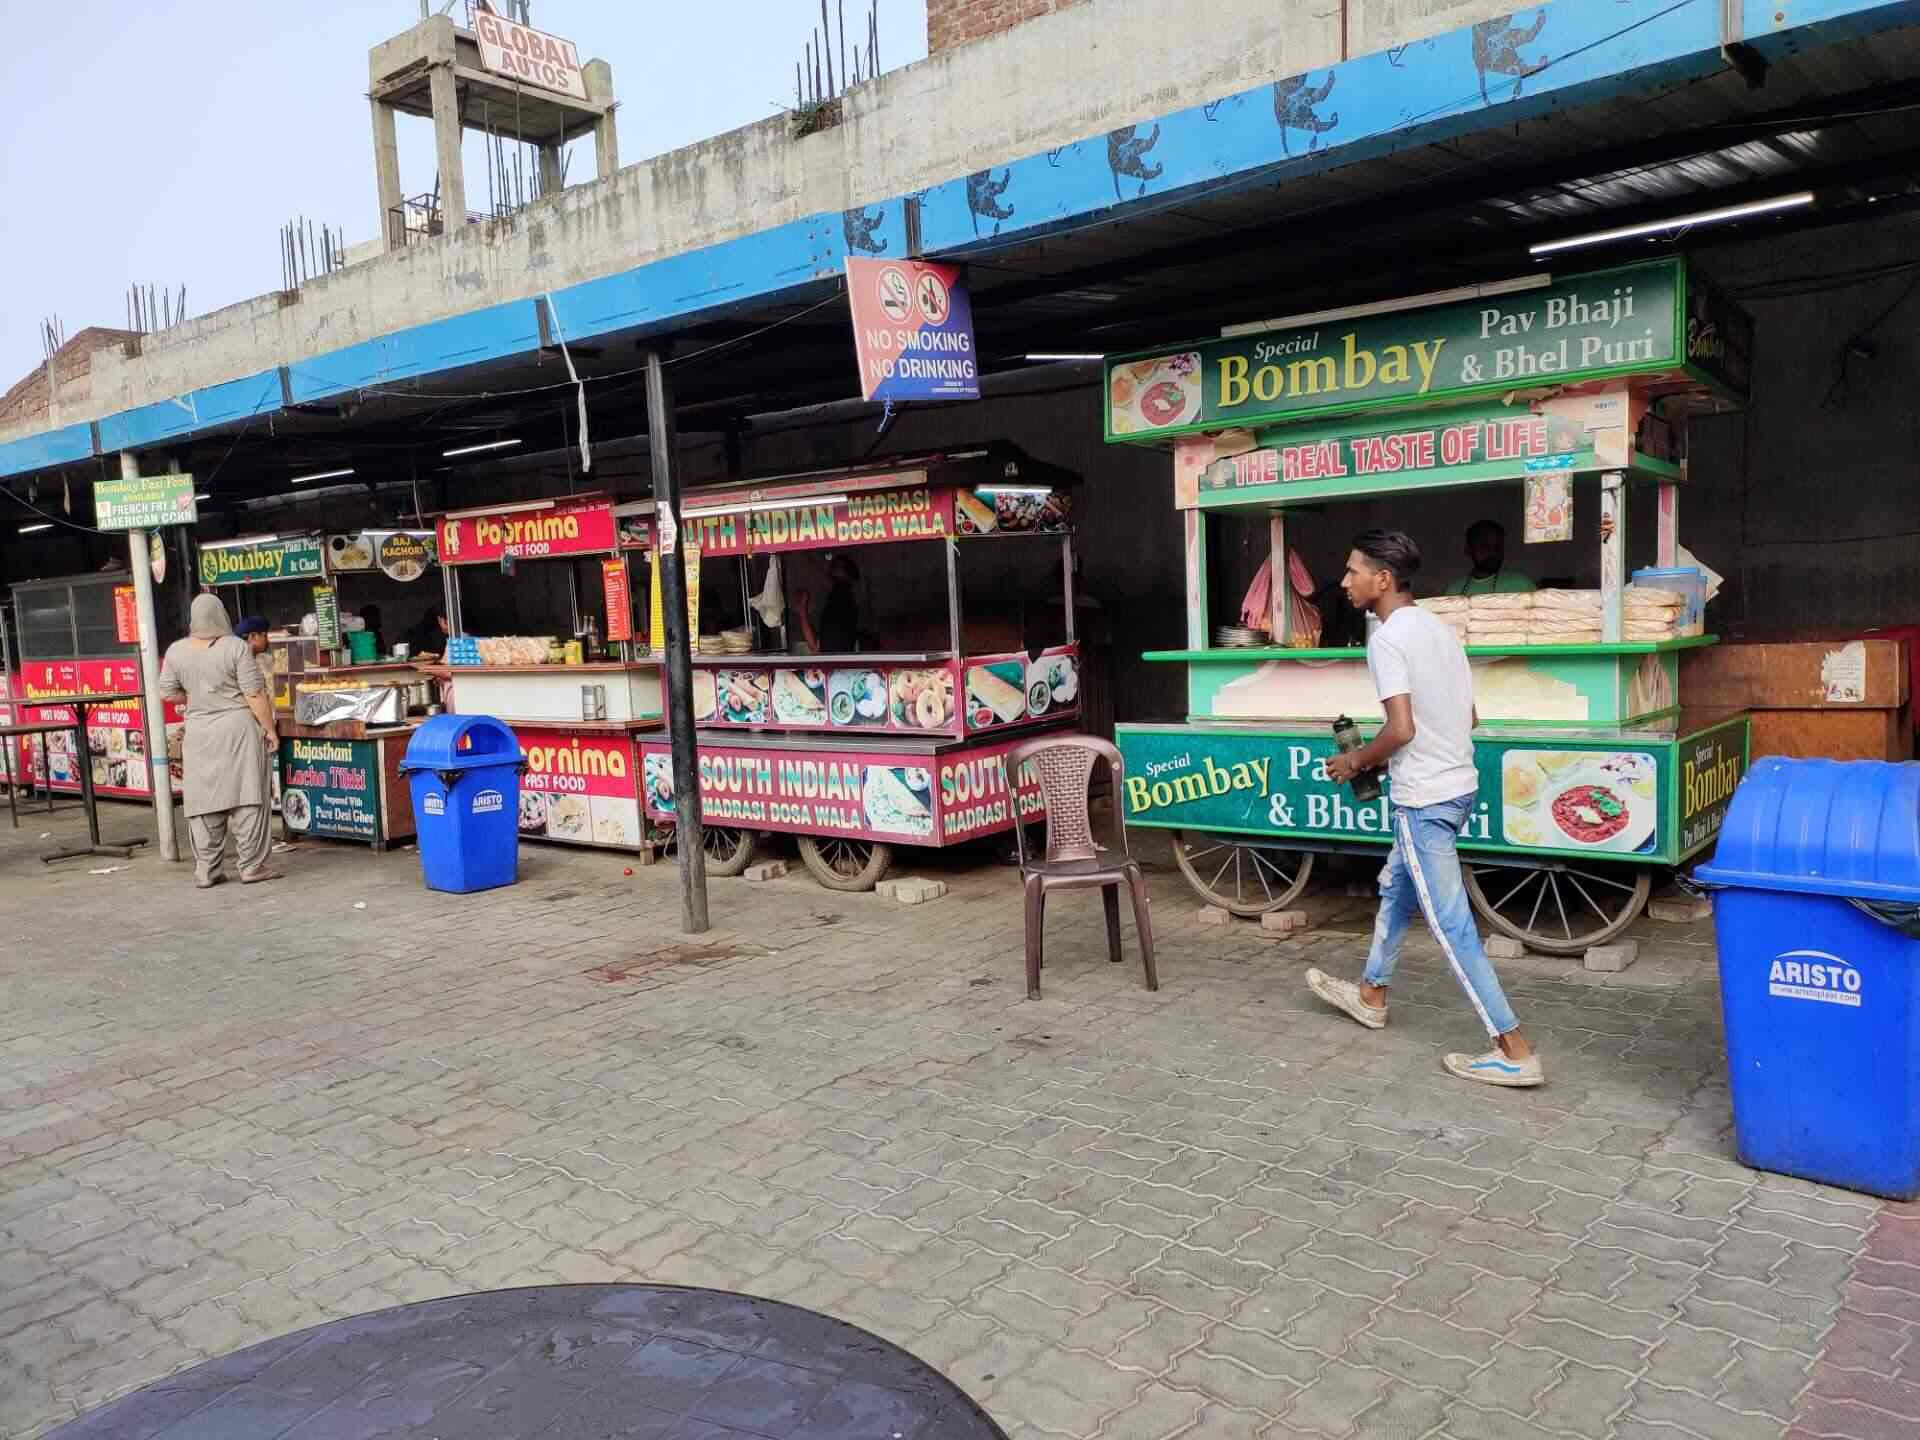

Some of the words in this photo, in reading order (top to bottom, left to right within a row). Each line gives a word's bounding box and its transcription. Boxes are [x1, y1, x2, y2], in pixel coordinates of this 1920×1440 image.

[479, 15, 578, 72] GLOBAL
[502, 51, 568, 88] AUTOS
[1479, 308, 1536, 340] Pav
[1544, 286, 1635, 328] Bhaji
[865, 329, 892, 350] NO
[896, 330, 970, 352] SMOKING
[1254, 331, 1319, 362] Special
[1460, 354, 1482, 384] &
[1495, 339, 1569, 380] Bhel
[1581, 328, 1655, 368] Puri
[869, 358, 895, 378] NO
[899, 358, 974, 379] DRINKING
[1216, 332, 1447, 408] Bombay
[1231, 451, 1278, 486] THE
[1282, 442, 1346, 482] REAL
[1352, 429, 1436, 474] TASTE
[1441, 424, 1482, 465] OF
[1485, 416, 1548, 460] LIFE
[847, 489, 931, 518] MADRASI
[476, 512, 579, 546] Poornima
[745, 505, 836, 545] INDIAN
[837, 517, 887, 542] DOSA
[892, 511, 945, 536] WALA
[218, 547, 284, 577] Bombay
[525, 542, 550, 555] FOOD
[293, 739, 353, 764] Rajasthani
[1145, 752, 1192, 778] Special
[1287, 745, 1330, 782] Pa
[525, 774, 550, 789] FAST
[552, 776, 586, 791] FOOD
[700, 755, 773, 795] SOUTH
[778, 759, 860, 801] INDIAN
[1124, 755, 1272, 814] Bombay
[1684, 744, 1740, 818] Bombay
[315, 806, 333, 819] Pure
[334, 807, 352, 821] Desi
[353, 809, 375, 824] Ghee
[472, 793, 503, 807] ARISTO
[702, 797, 766, 822] MADRASI
[770, 802, 812, 826] DOSA
[815, 804, 862, 830] WALA
[1267, 792, 1296, 827] &
[1304, 793, 1391, 832] Bhel
[943, 800, 1008, 837] MADRASI
[1769, 959, 1862, 992] ARISTO
